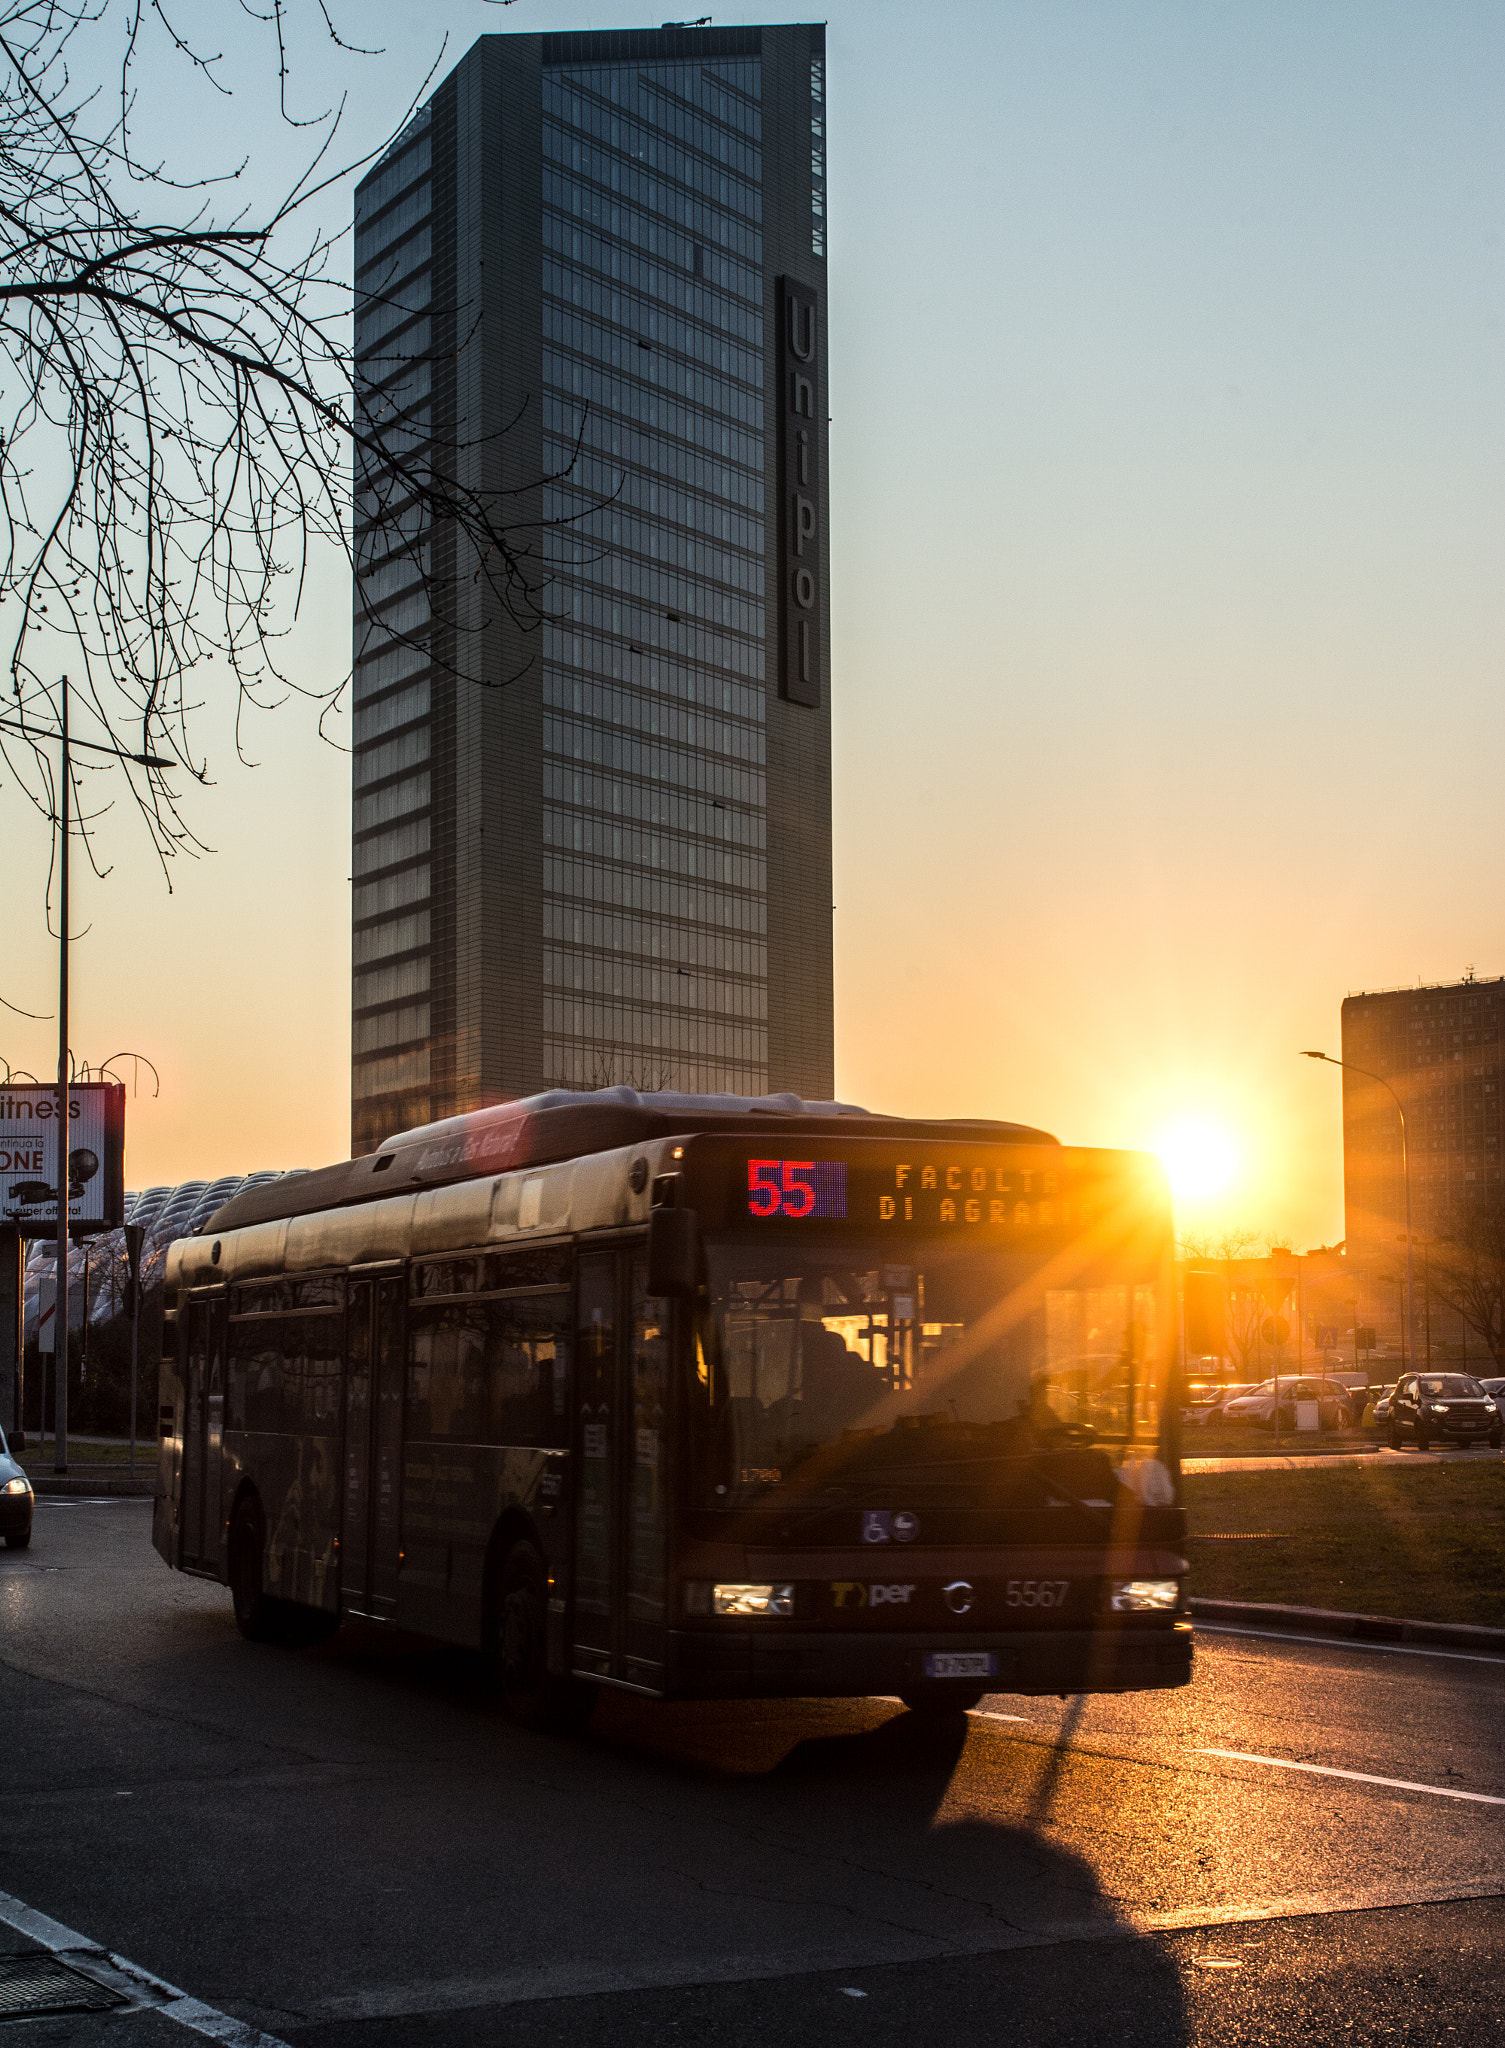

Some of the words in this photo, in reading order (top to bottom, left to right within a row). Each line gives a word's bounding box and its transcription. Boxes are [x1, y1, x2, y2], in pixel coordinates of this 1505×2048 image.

[789, 295, 816, 682] Unipol
[35, 1139, 44, 1148] la
[747, 1159, 816, 1217] 55
[45, 1206, 81, 1215] offta!
[879, 1196, 913, 1220] DI
[939, 1198, 1095, 1225] AGRARIA
[1006, 1580, 1070, 1607] 5567
